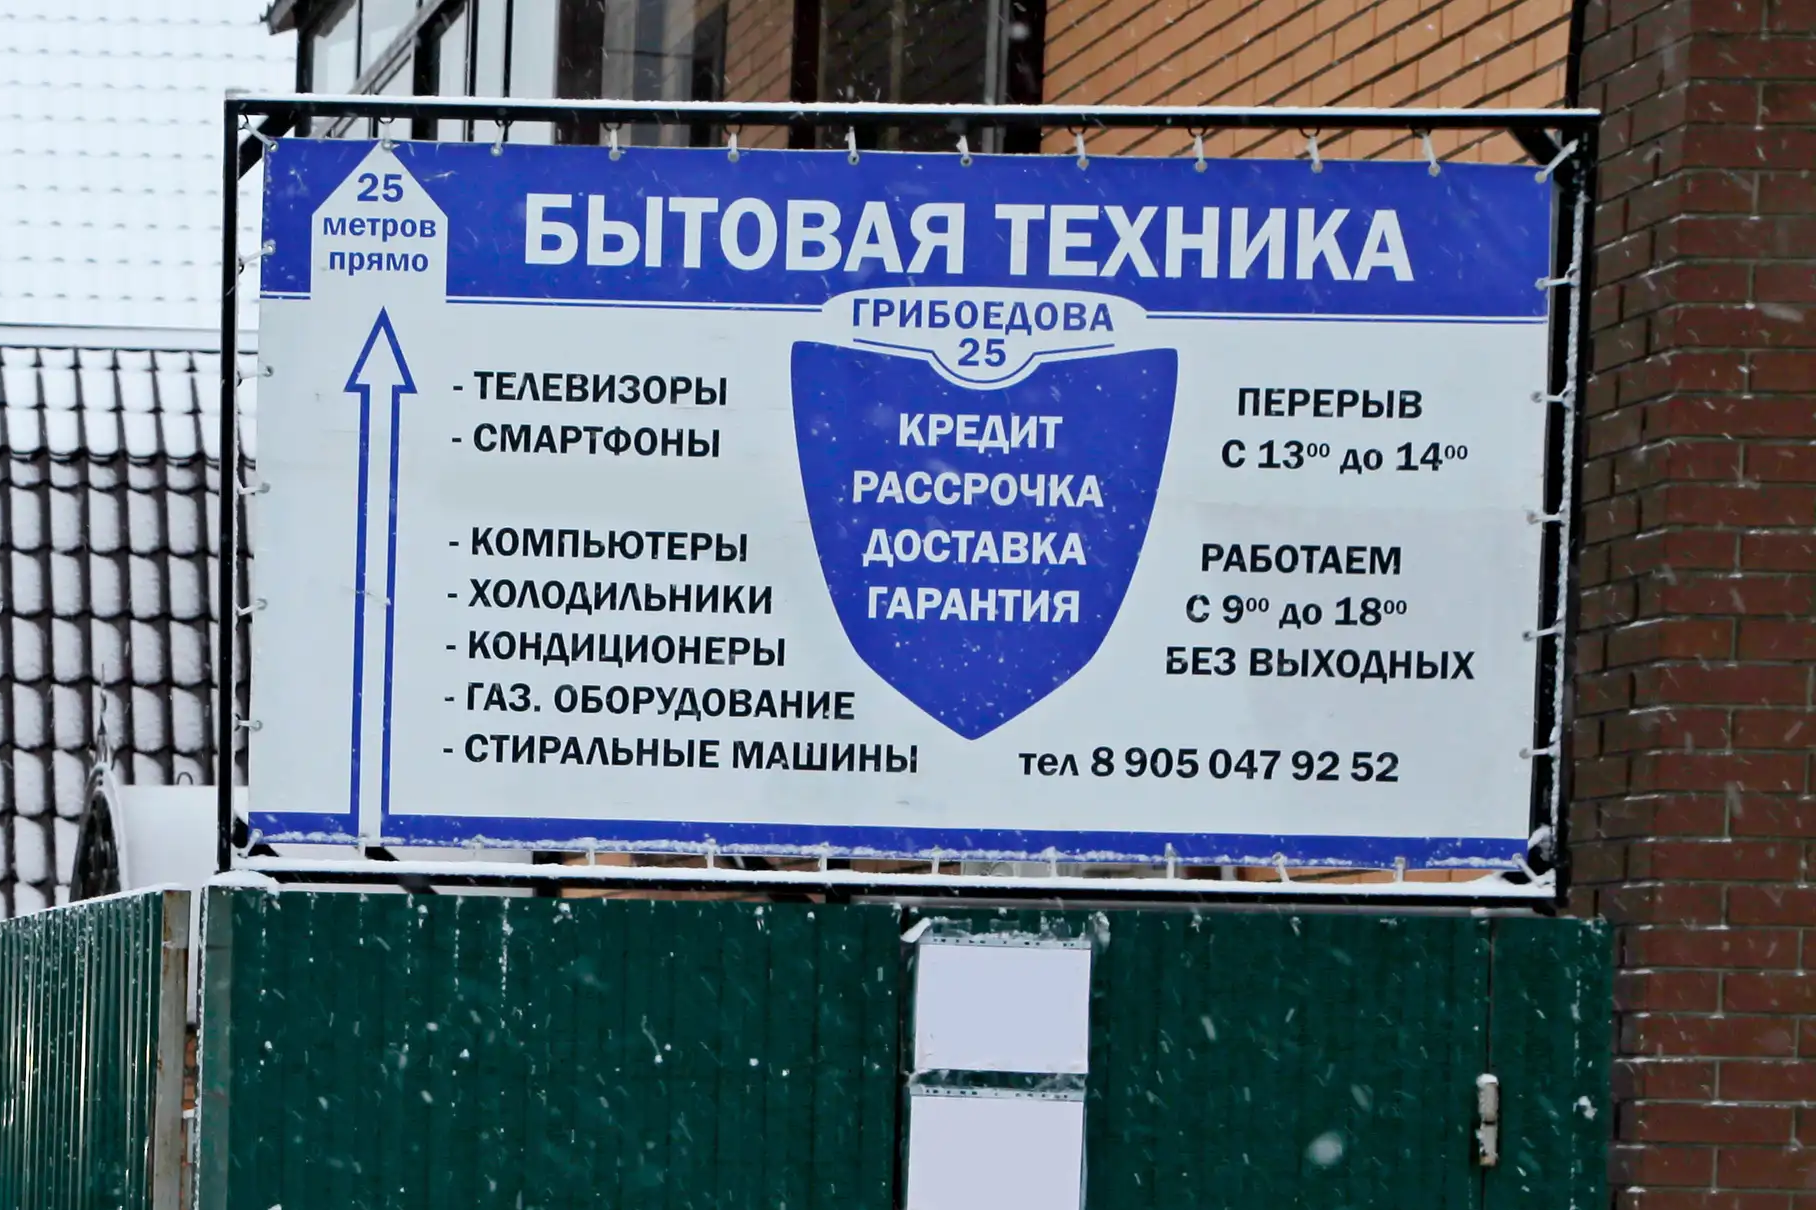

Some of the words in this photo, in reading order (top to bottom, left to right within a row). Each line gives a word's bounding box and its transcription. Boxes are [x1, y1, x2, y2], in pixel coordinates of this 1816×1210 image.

[357, 172, 404, 203] 25
[323, 217, 437, 243] метров
[524, 192, 966, 275] БЫТОВАЯ
[994, 203, 1415, 282] ТЕХНИКА
[329, 251, 429, 277] прямо
[852, 298, 1114, 337] ГРИБОЕДОВА
[957, 337, 1006, 368] 25
[473, 370, 727, 406] ТЕЛЕВИЗОРЫ
[1238, 387, 1423, 419] ПЕРЕРЫВ
[473, 422, 720, 458] СМАРТФОНЫ
[899, 412, 1063, 455] КРЕДИТ
[1221, 439, 1246, 469] С
[1339, 448, 1384, 475] до
[852, 470, 1104, 508] РАССРОЧКА
[471, 526, 748, 562] КОМПЬЮТЕРЫ
[862, 528, 1087, 568] ДОСТАВКА
[1201, 543, 1402, 575] РАБОТАЕМ
[468, 578, 772, 616] ХОЛОДИЛЬНИКИ
[868, 586, 1080, 623] ГАРАНТИЯ
[1186, 594, 1210, 623] С
[1278, 603, 1323, 630] до
[468, 630, 785, 669] КОНДИЦИОНЕРЫ
[1166, 646, 1236, 676] БЕЗ
[1249, 647, 1475, 685] ВЫХОДНЫХ
[467, 682, 541, 712] ГАЗ.
[554, 684, 856, 722] ОБОРУДОВАНИЕ
[464, 733, 720, 769] СТИРАЛЬНЫЕ
[732, 740, 918, 774] МАШИНЫ
[1018, 752, 1080, 777] тел
[1090, 746, 1115, 777] 8
[1124, 746, 1199, 779] 905
[1208, 748, 1281, 780] 047
[1291, 750, 1340, 781] 92
[1350, 751, 1399, 783] 52
